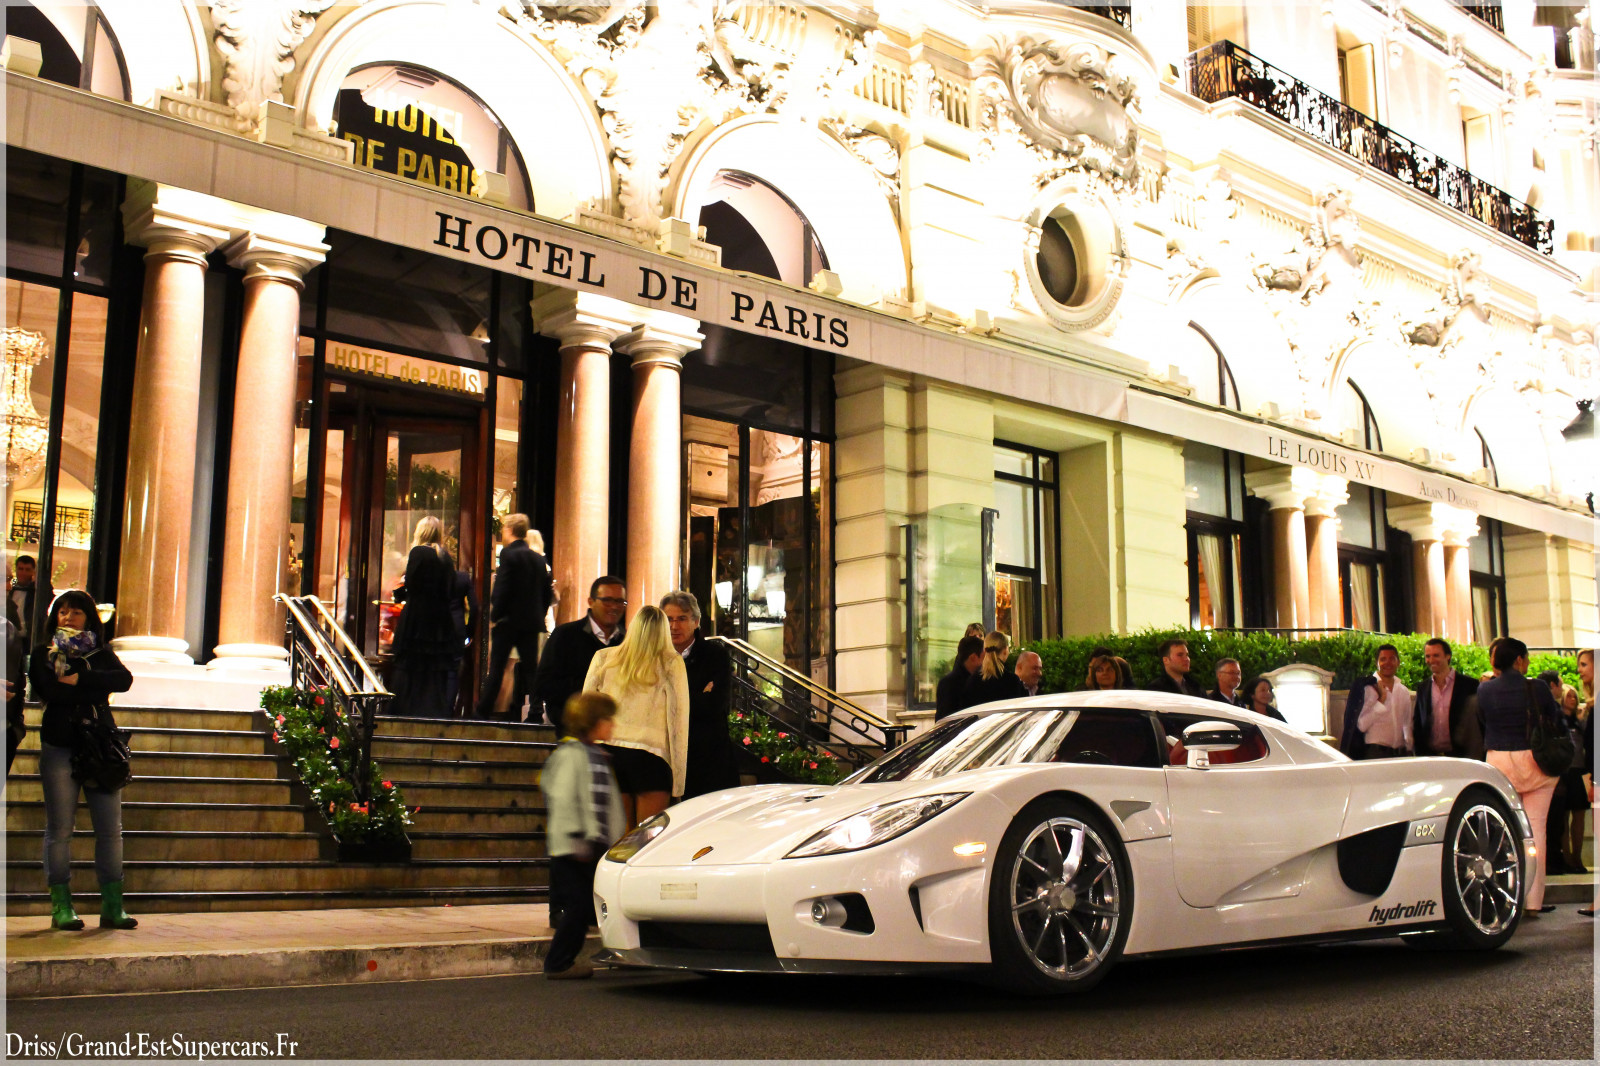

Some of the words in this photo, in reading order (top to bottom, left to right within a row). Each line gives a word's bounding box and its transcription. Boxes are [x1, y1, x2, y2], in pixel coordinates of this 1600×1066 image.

[374, 88, 471, 150] HOTEL
[433, 211, 605, 288] HOTEL
[637, 266, 698, 312] DE
[730, 291, 849, 348] PARIS
[334, 346, 394, 380] HOTEL
[400, 361, 420, 385] de
[426, 365, 478, 395] PARIS
[1268, 436, 1289, 459] LE
[1297, 443, 1347, 474] LOUIS
[1355, 460, 1375, 480] XV
[1368, 899, 1437, 926] hydrolift
